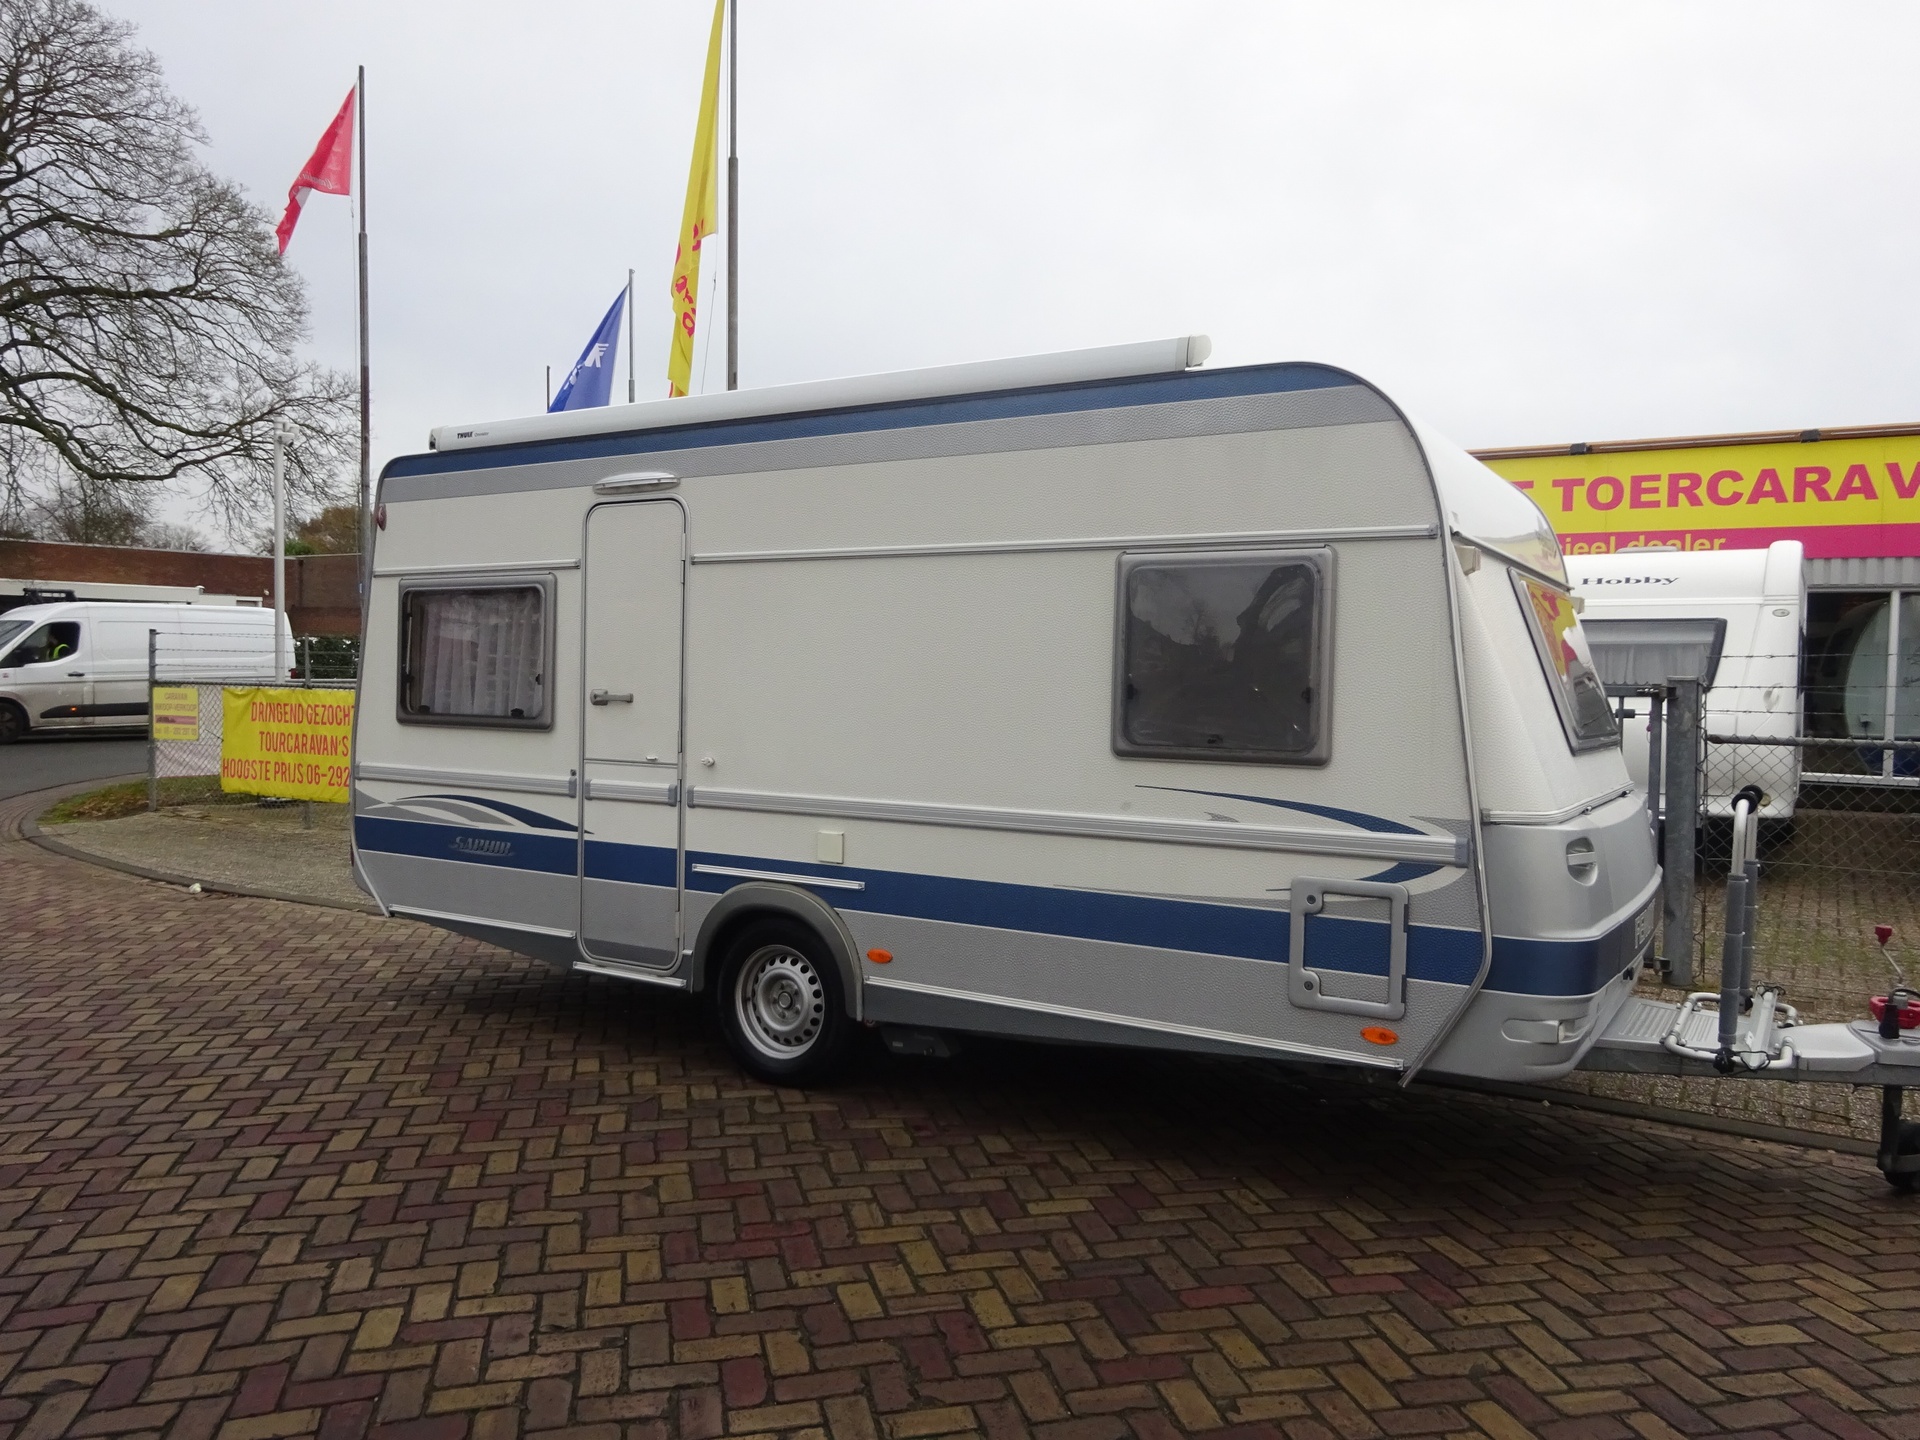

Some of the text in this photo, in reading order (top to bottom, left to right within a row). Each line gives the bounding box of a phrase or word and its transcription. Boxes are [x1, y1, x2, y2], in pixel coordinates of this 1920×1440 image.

[1551, 461, 1920, 512] TOERCARAV
[1560, 535, 1616, 555] ieel
[1580, 576, 1680, 586] Hobby
[251, 701, 304, 724] DRINGEND
[259, 731, 349, 757] TOURCARAVAN'S
[222, 758, 271, 781] HOOGSTE
[273, 761, 304, 784] PRIJS
